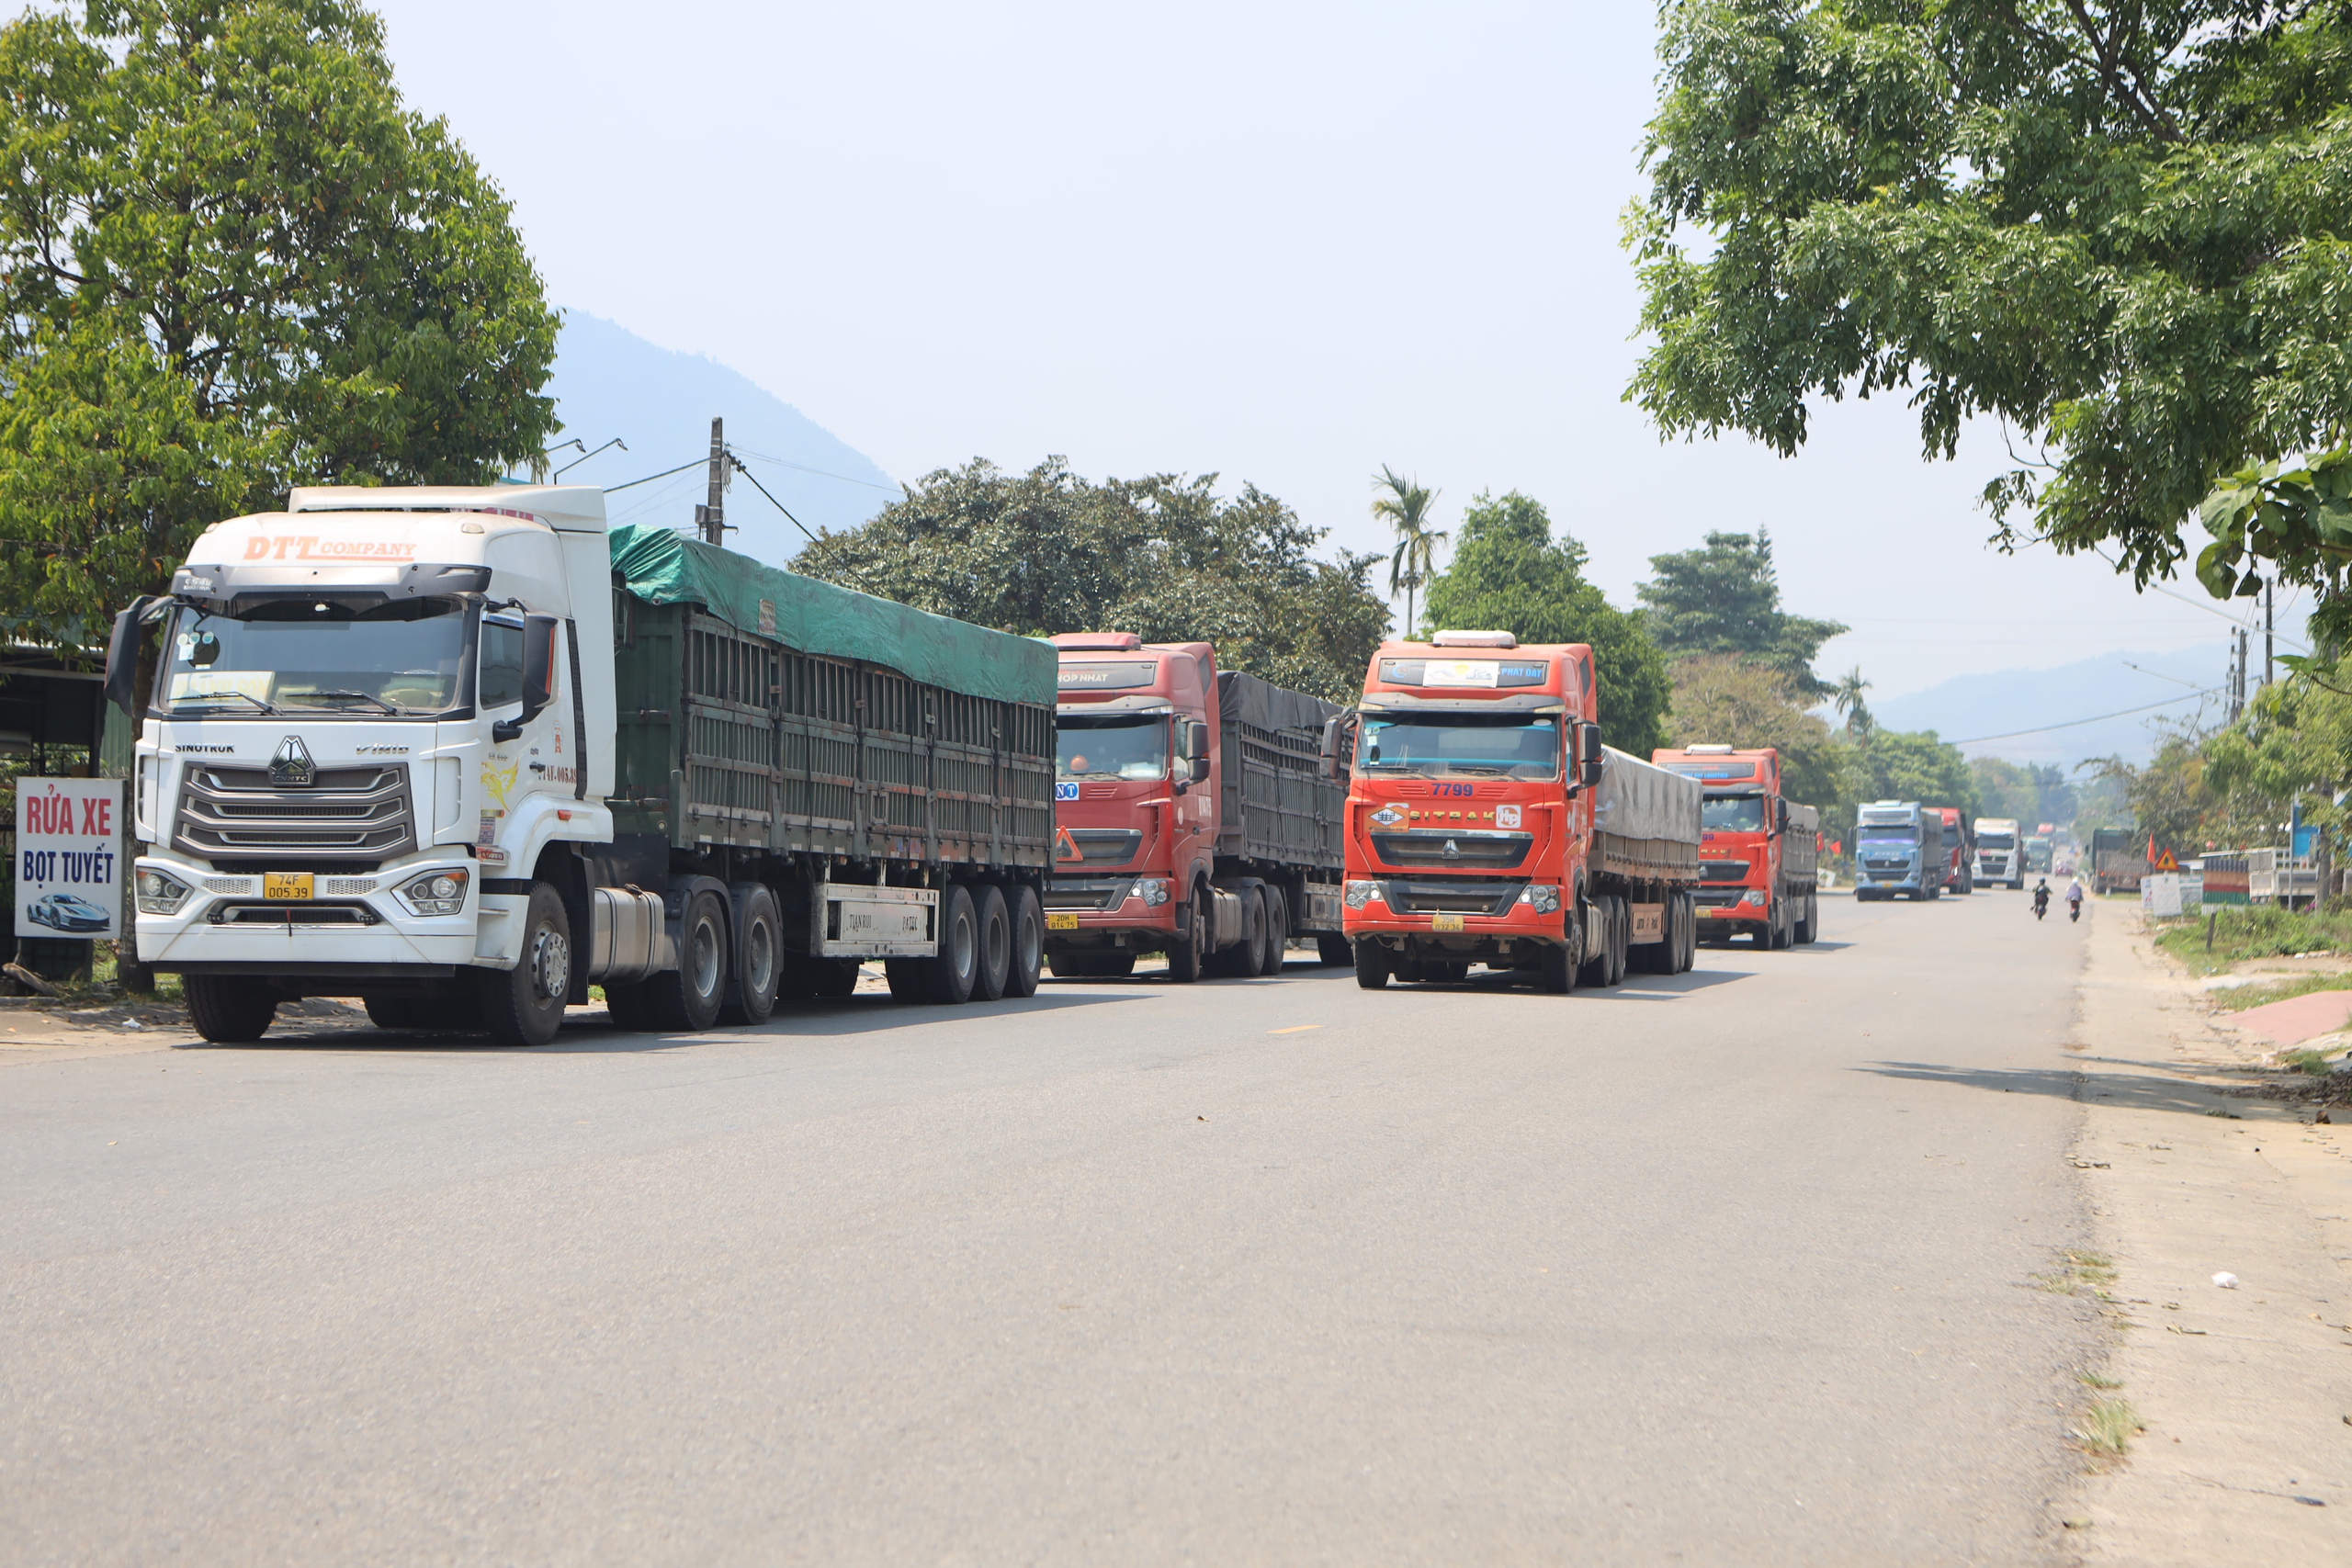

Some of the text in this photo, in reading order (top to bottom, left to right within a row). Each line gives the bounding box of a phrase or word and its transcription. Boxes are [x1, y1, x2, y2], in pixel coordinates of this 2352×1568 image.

[243, 536, 417, 560] DTT COMPANY
[1079, 673, 1108, 682] NHAT
[175, 742, 235, 753] SINOTRUK
[1431, 783, 1474, 797] 7799
[27, 784, 112, 836] RỬA XE
[1409, 810, 1495, 821] SITRAK
[23, 842, 114, 889] BỌT TUYẾT
[278, 874, 299, 886] 74F
[269, 886, 308, 898] 005.39
